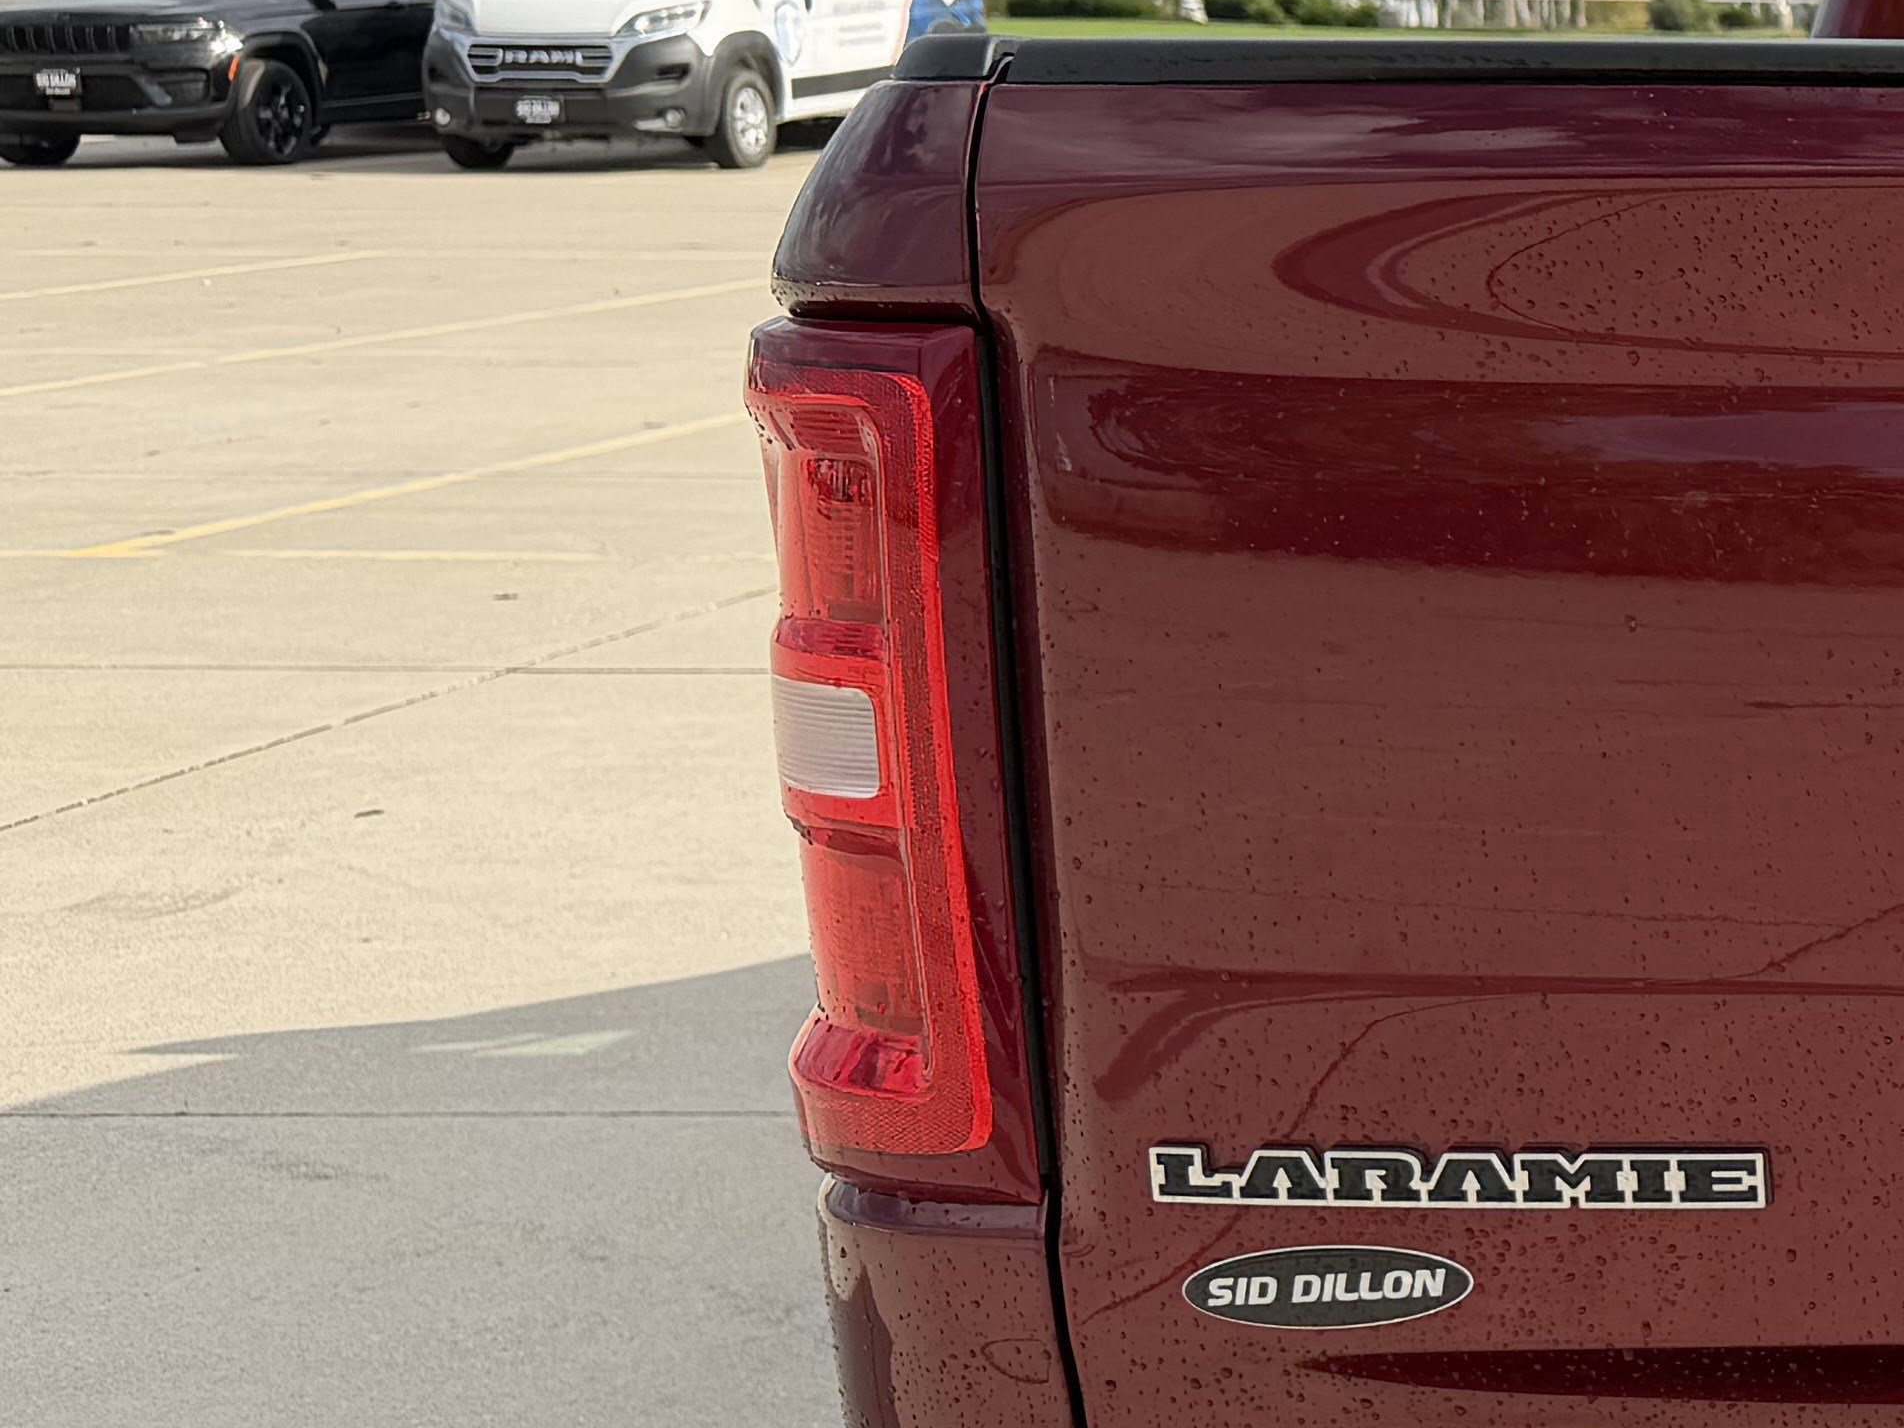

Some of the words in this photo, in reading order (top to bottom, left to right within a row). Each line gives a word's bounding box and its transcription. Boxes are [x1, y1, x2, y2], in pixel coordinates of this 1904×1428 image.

[1149, 1146, 1770, 1209] LARAMIE
[1207, 1275, 1278, 1307] SID
[1291, 1268, 1447, 1304] DILLON
